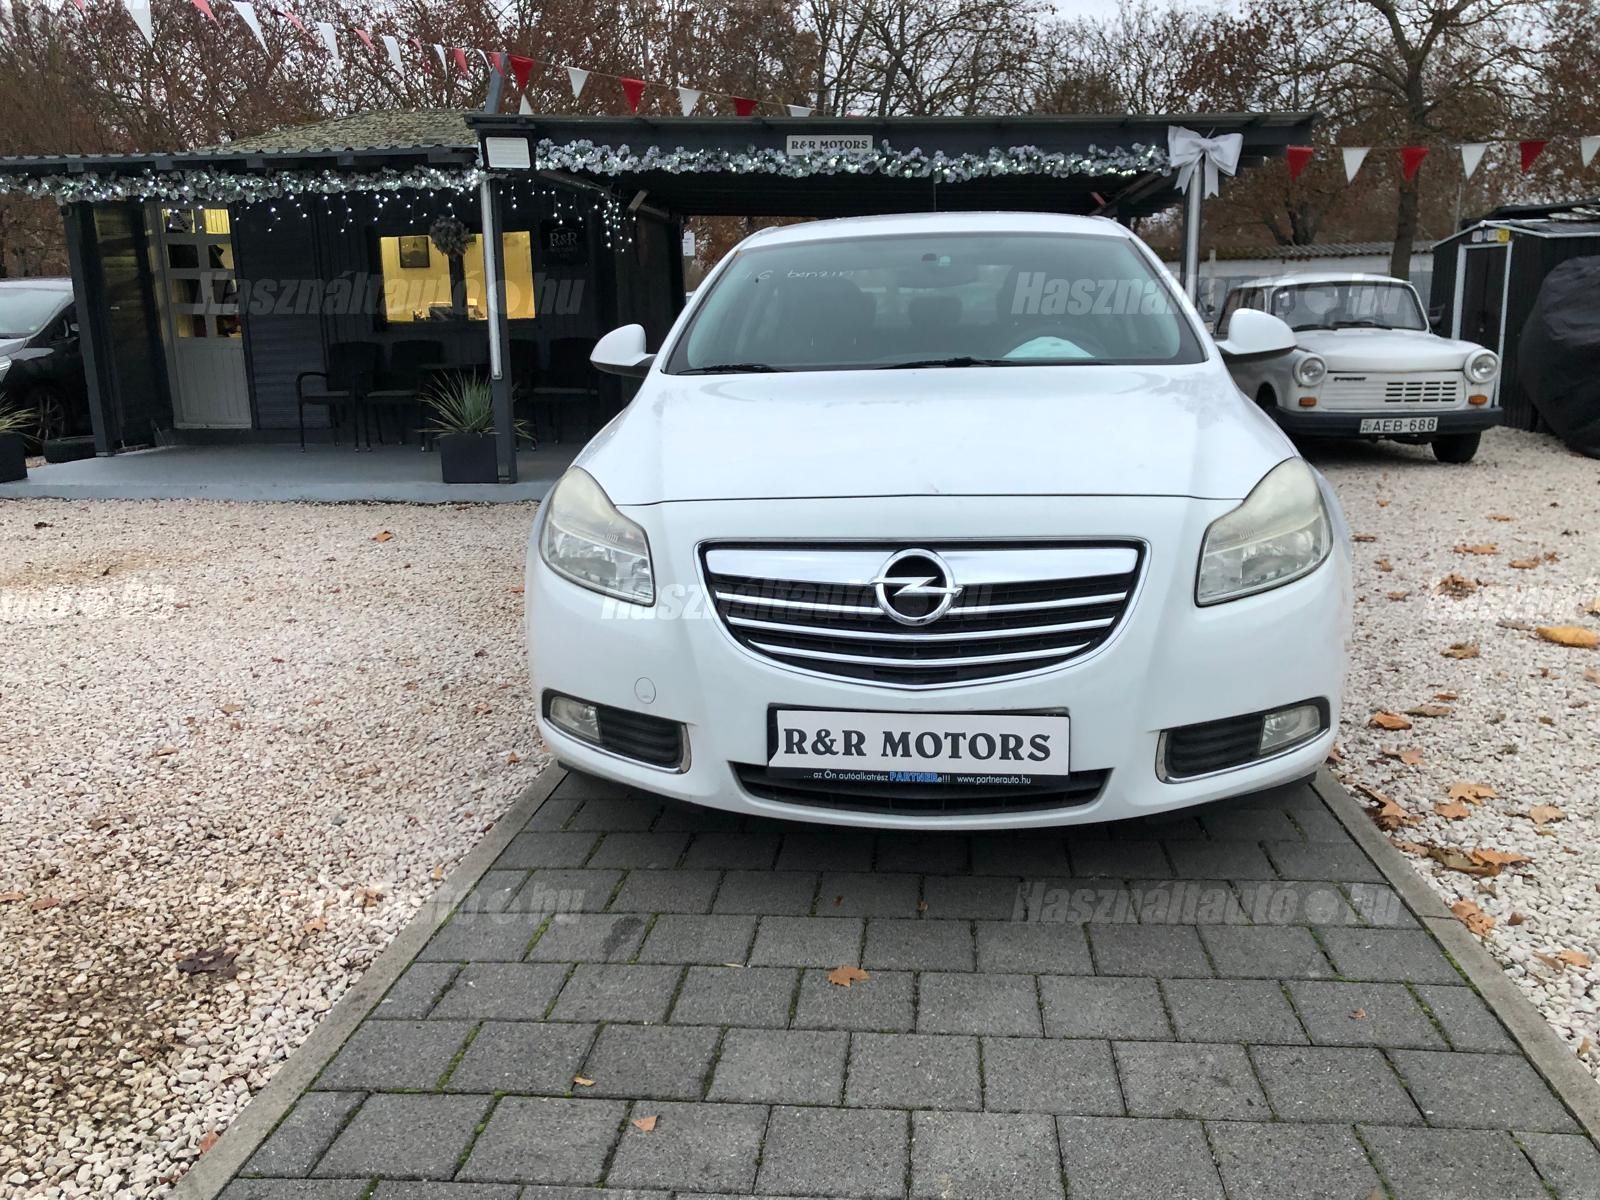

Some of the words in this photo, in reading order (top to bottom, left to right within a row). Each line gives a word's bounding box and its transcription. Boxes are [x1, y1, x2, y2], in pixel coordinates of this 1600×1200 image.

[791, 140, 816, 150] R&R
[820, 140, 868, 150] MOTORS
[549, 232, 577, 247] R&R
[1373, 419, 1435, 432] AEB-688
[784, 728, 867, 757] R&R
[881, 731, 1051, 762] MOTORS
[838, 771, 889, 781] autóalkatrész
[957, 774, 1032, 785] www.partnerauto.hu
